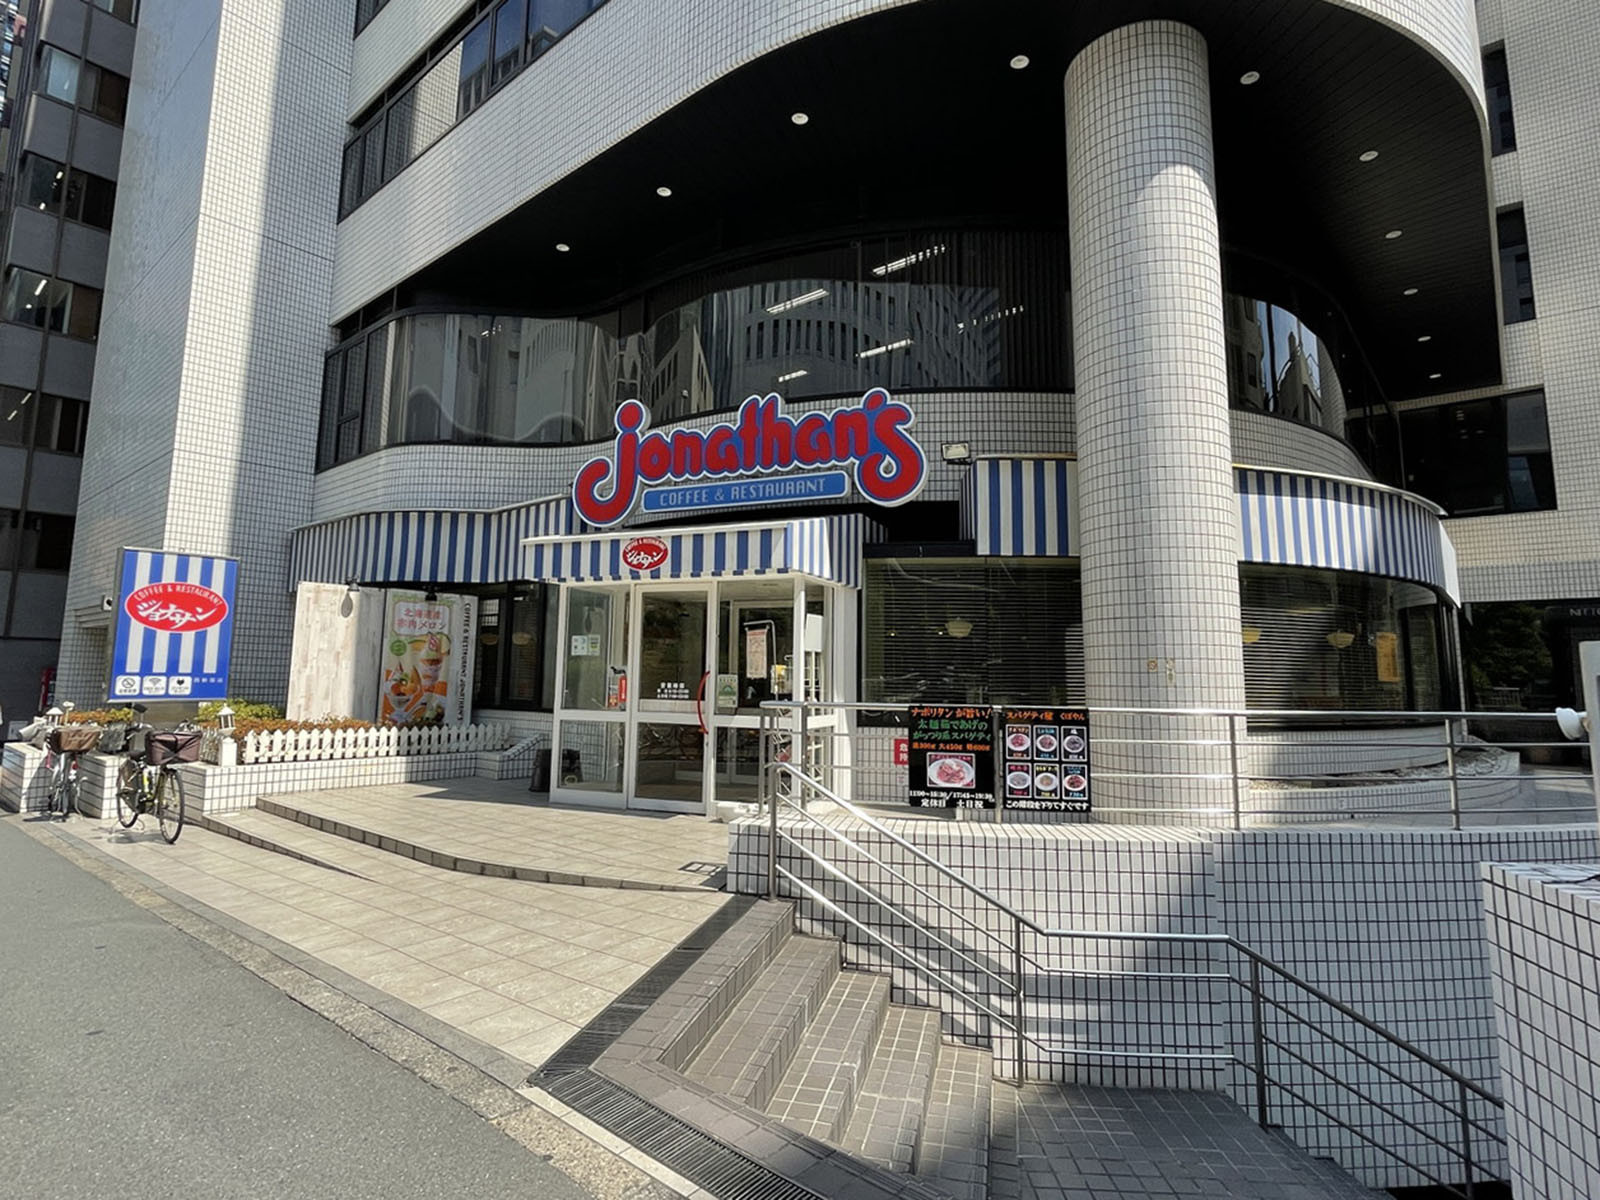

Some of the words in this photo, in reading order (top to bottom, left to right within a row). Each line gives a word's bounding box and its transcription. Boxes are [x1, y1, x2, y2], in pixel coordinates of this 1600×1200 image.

[659, 488, 709, 506] COFFEE
[714, 487, 725, 502] &
[731, 478, 826, 501] RESTAURANT
[134, 584, 164, 601] COFFEE
[167, 584, 173, 593] &
[175, 584, 223, 606] RESTAURANT
[462, 602, 472, 627] COFFEE
[460, 635, 469, 677] RESTAURANT
[920, 798, 946, 808] 定休日
